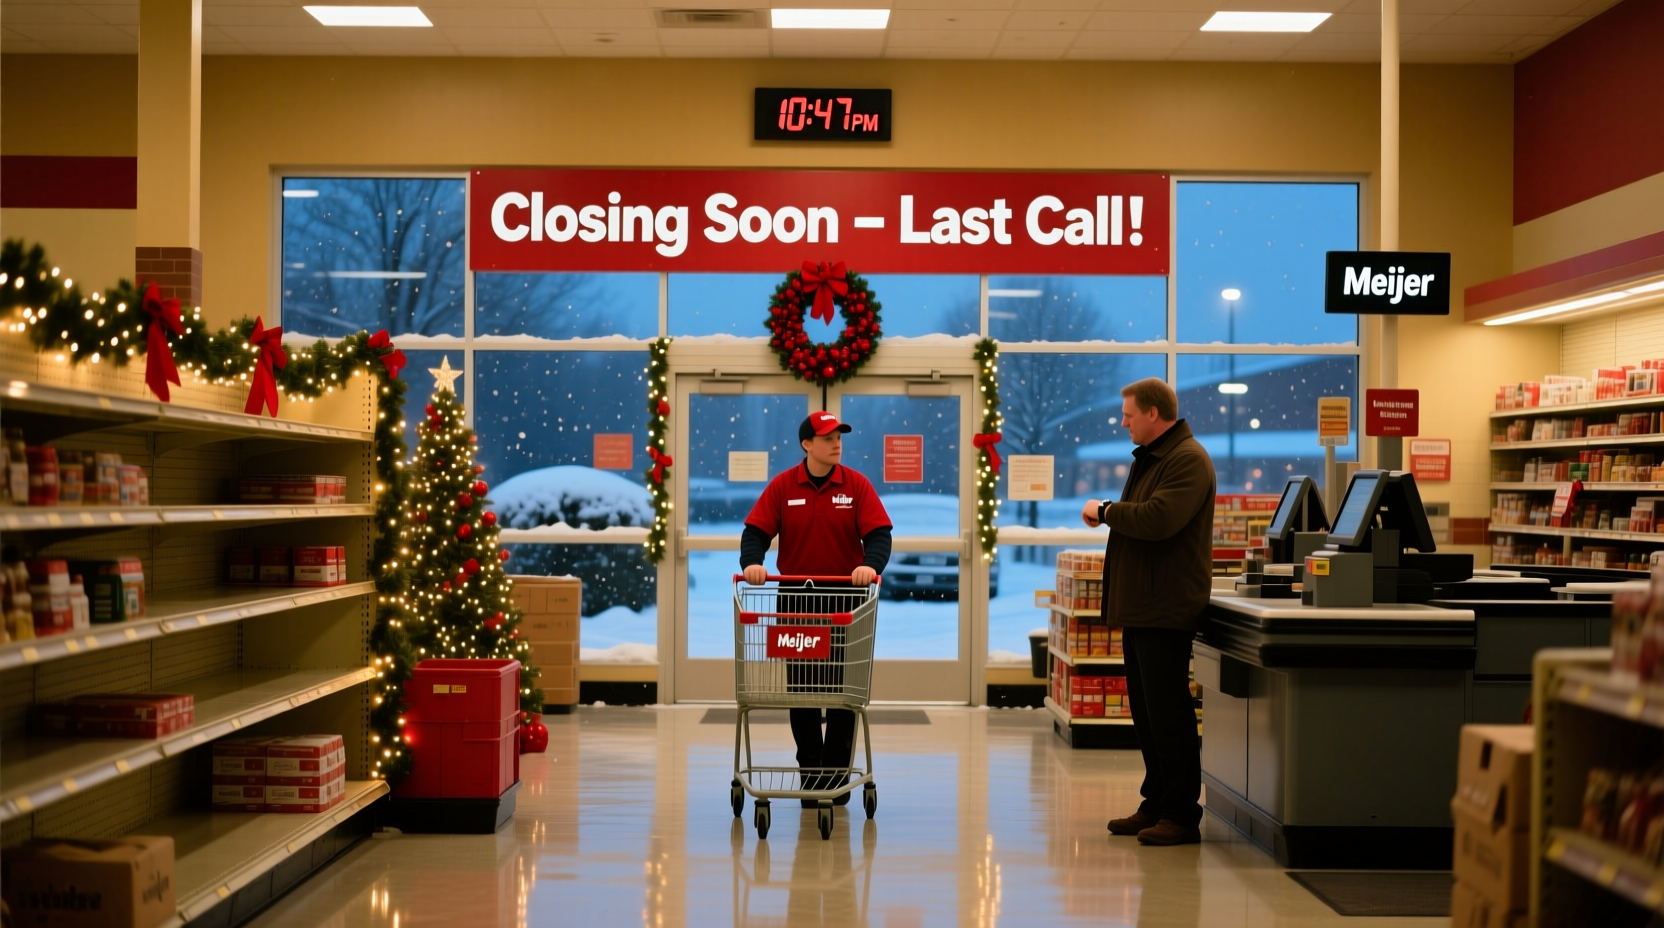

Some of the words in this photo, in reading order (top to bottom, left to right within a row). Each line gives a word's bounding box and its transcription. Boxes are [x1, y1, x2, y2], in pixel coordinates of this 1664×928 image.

[490, 190, 689, 258] Closing
[703, 192, 839, 245] Soon
[899, 194, 1013, 246] Last
[1026, 194, 1145, 247] Call!
[1343, 266, 1435, 305] Meijer
